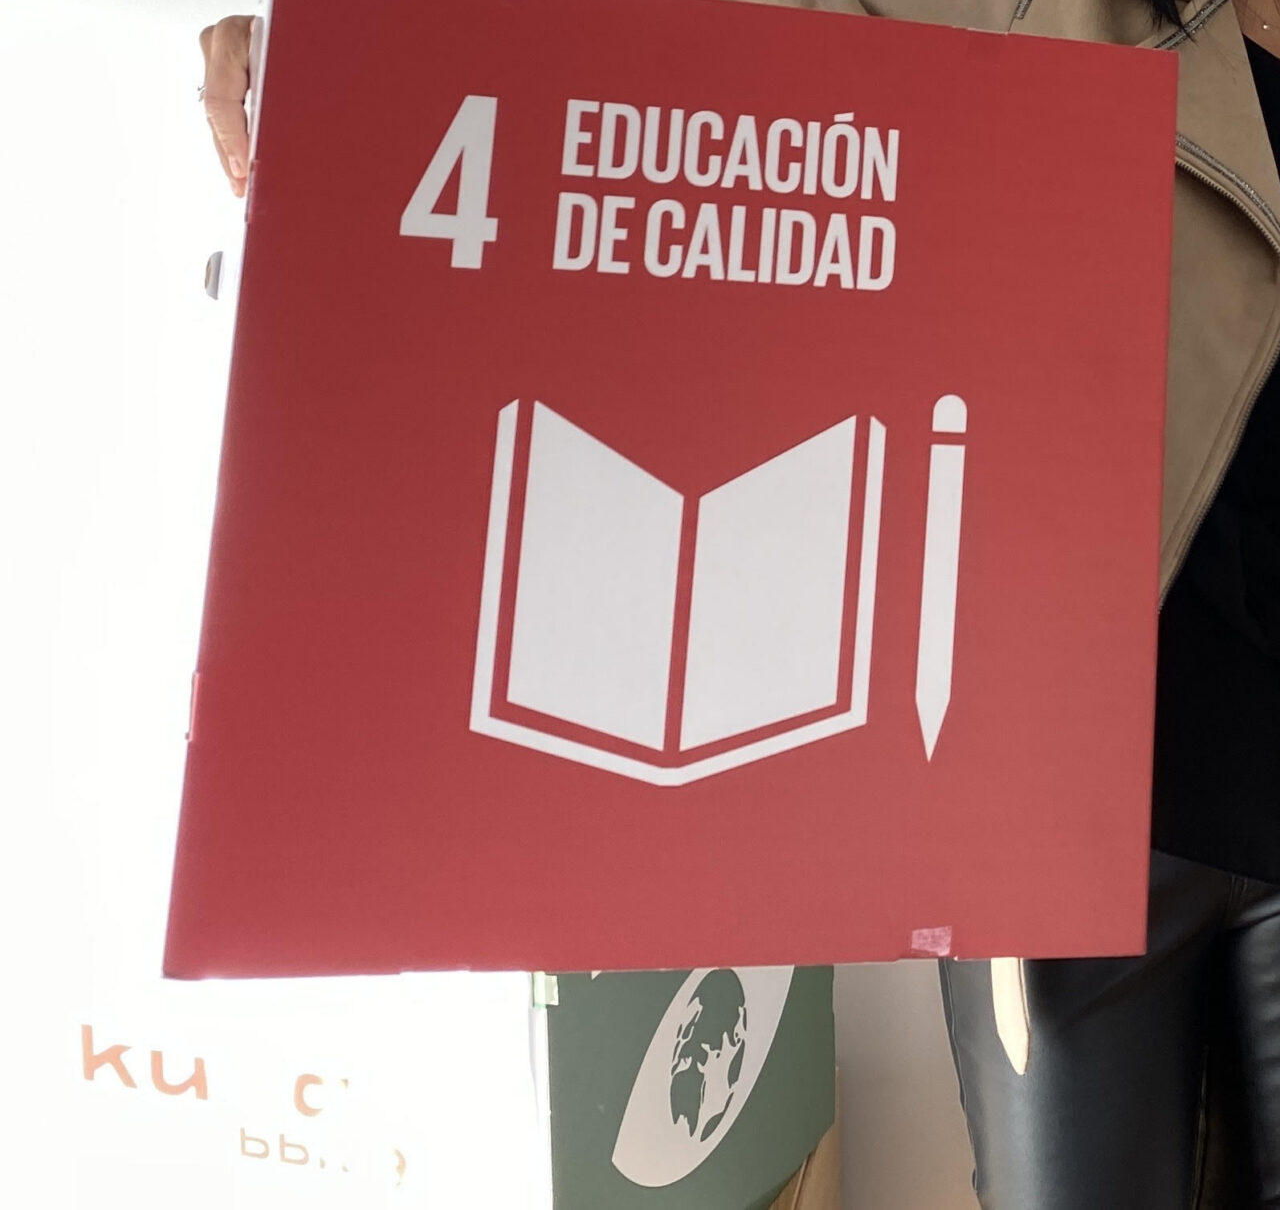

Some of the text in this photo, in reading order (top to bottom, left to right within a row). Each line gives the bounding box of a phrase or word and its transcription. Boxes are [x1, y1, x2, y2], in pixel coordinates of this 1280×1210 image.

[399, 94, 900, 269] 4 EDUCACIÓN
[553, 192, 896, 291] DE CALIDAD
